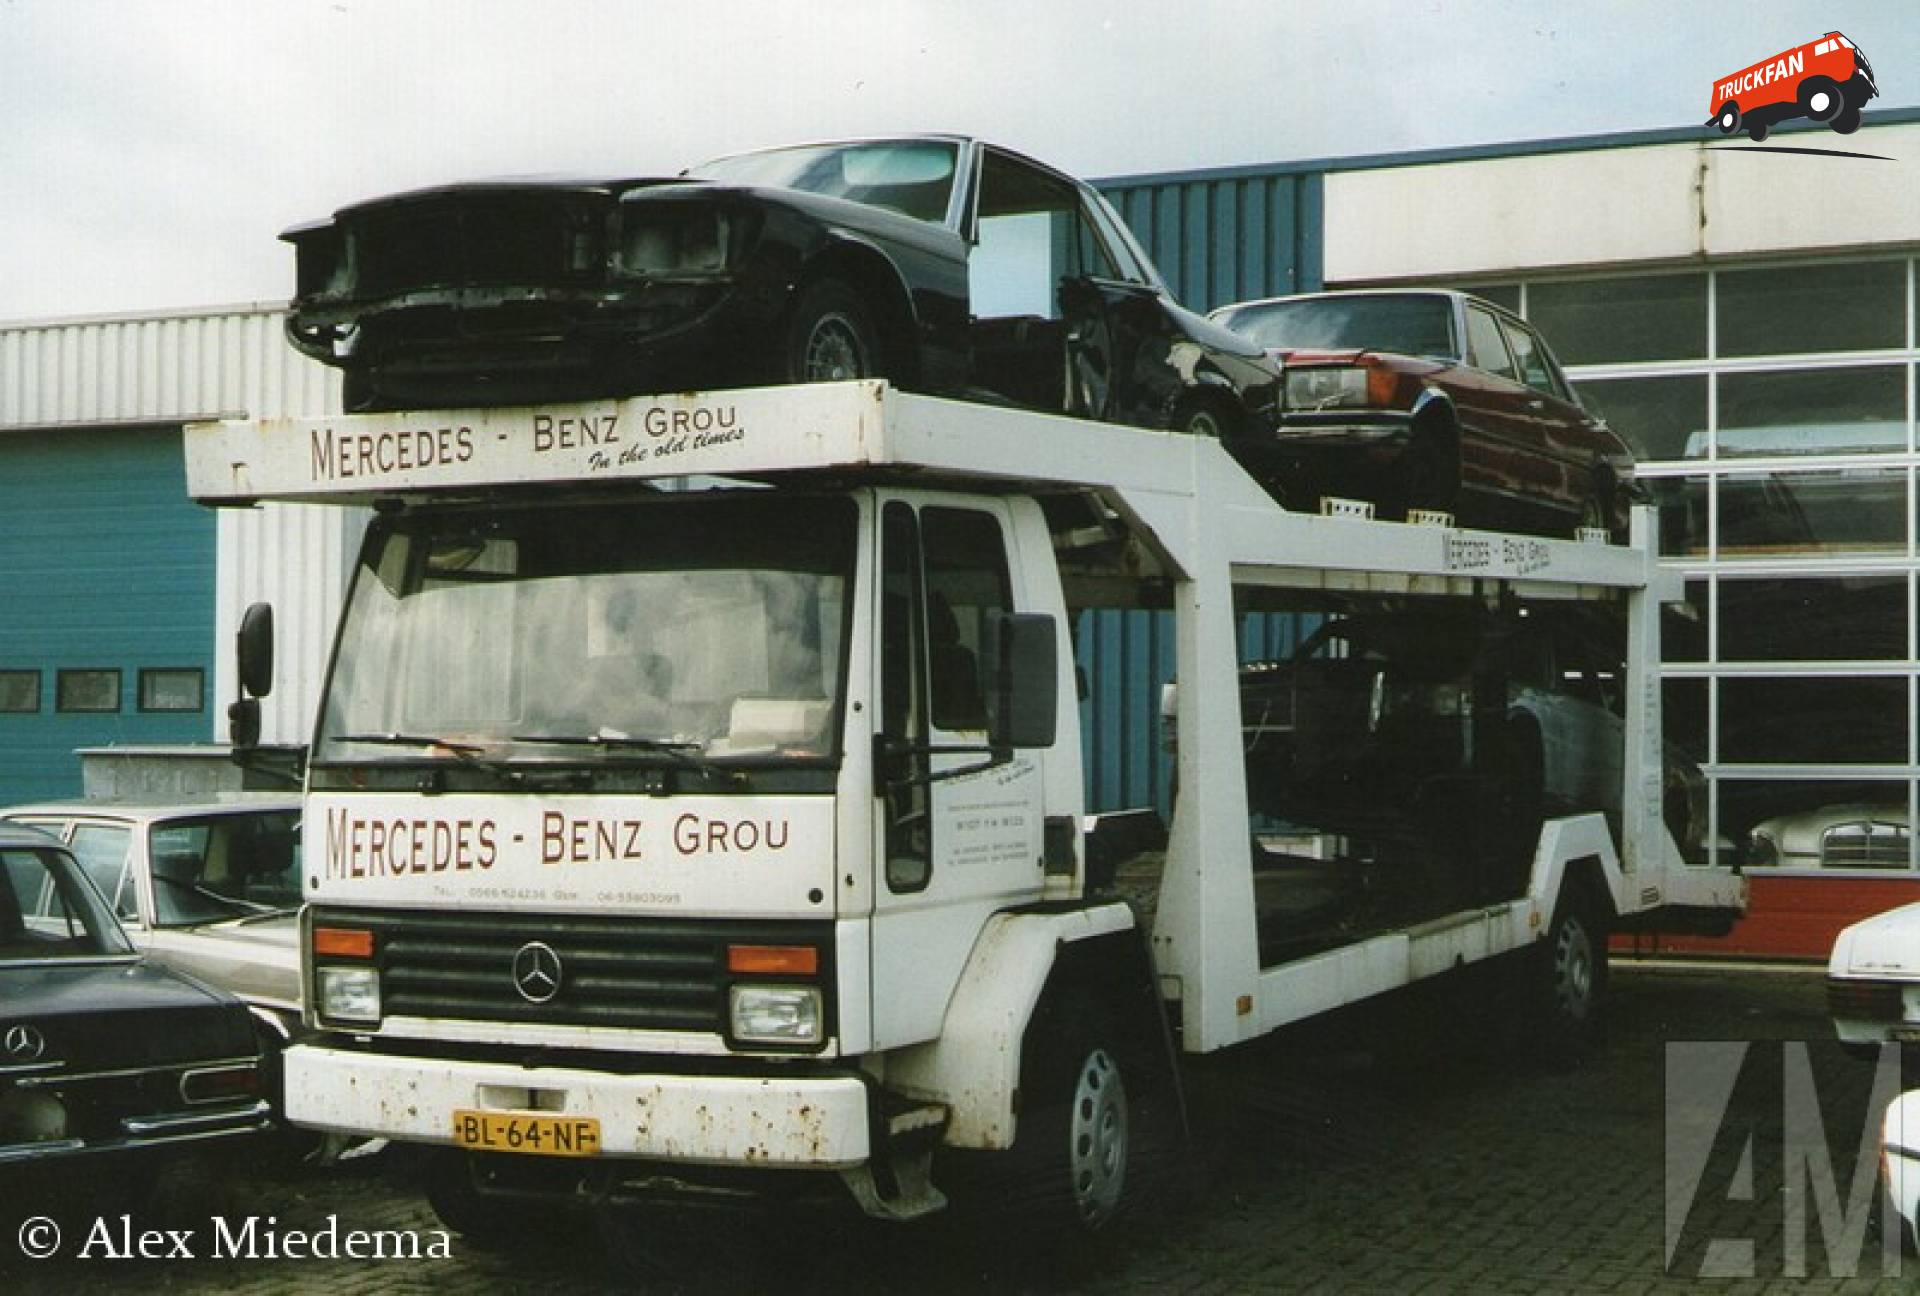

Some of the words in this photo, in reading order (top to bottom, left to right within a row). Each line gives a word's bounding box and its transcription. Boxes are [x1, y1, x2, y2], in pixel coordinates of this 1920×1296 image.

[310, 426, 474, 481] MERCEDES
[534, 414, 620, 452] BENZ
[645, 406, 736, 437] GROU
[618, 441, 649, 466] the
[654, 434, 689, 457] old
[693, 427, 745, 450] times
[325, 807, 498, 881] MERCEDES
[541, 811, 643, 865] BENZ
[673, 813, 789, 856] GROU
[463, 1115, 595, 1152] BL-64-NF
